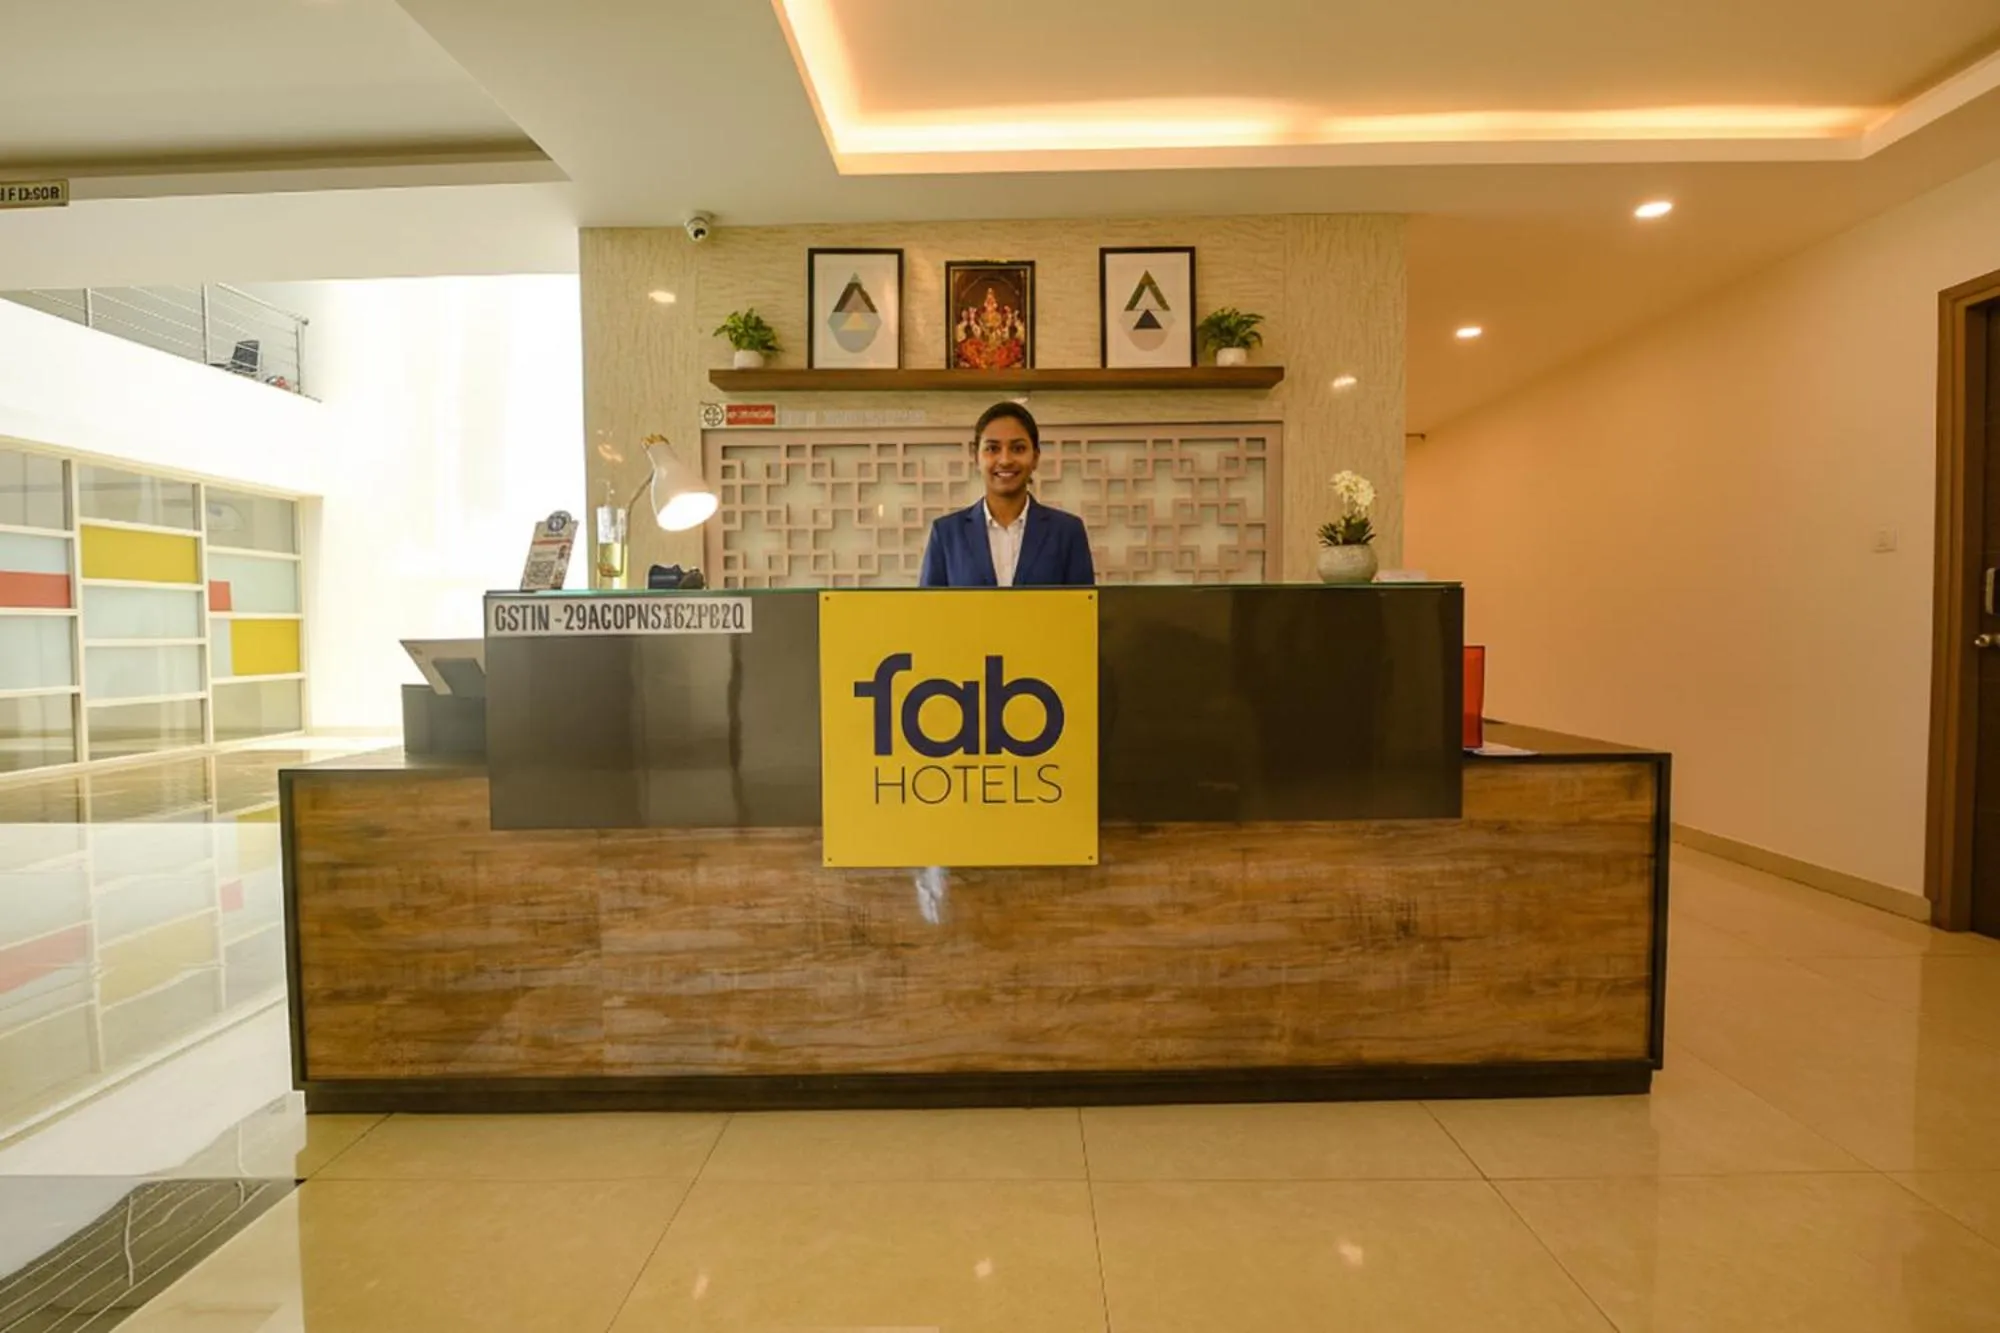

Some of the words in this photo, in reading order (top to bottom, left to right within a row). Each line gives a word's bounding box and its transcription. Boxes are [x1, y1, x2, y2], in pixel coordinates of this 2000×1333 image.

[494, 604, 550, 632] GSTIN
[854, 652, 1065, 758] fab
[875, 764, 1062, 804] HOTELS
